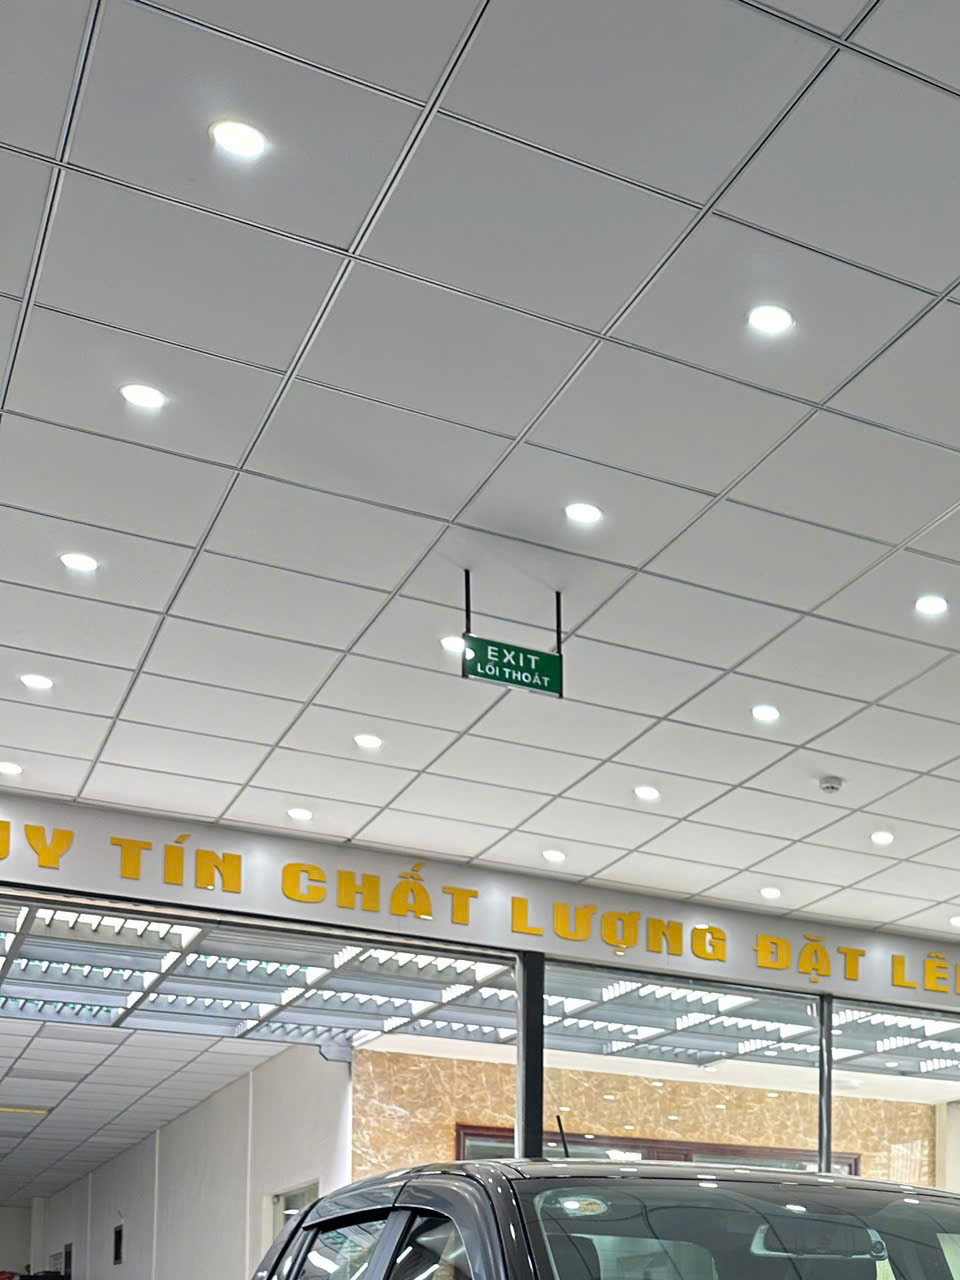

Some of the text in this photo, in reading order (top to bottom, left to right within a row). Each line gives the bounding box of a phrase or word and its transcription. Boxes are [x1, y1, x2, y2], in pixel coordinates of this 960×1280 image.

[487, 646, 540, 669] EXIT
[503, 669, 550, 687] THOÁT
[0, 820, 74, 870] Y
[110, 834, 242, 893] TÍN
[281, 862, 478, 926] CHẤT
[511, 896, 727, 962] LƯỢNG
[755, 933, 866, 983] ĐẶT
